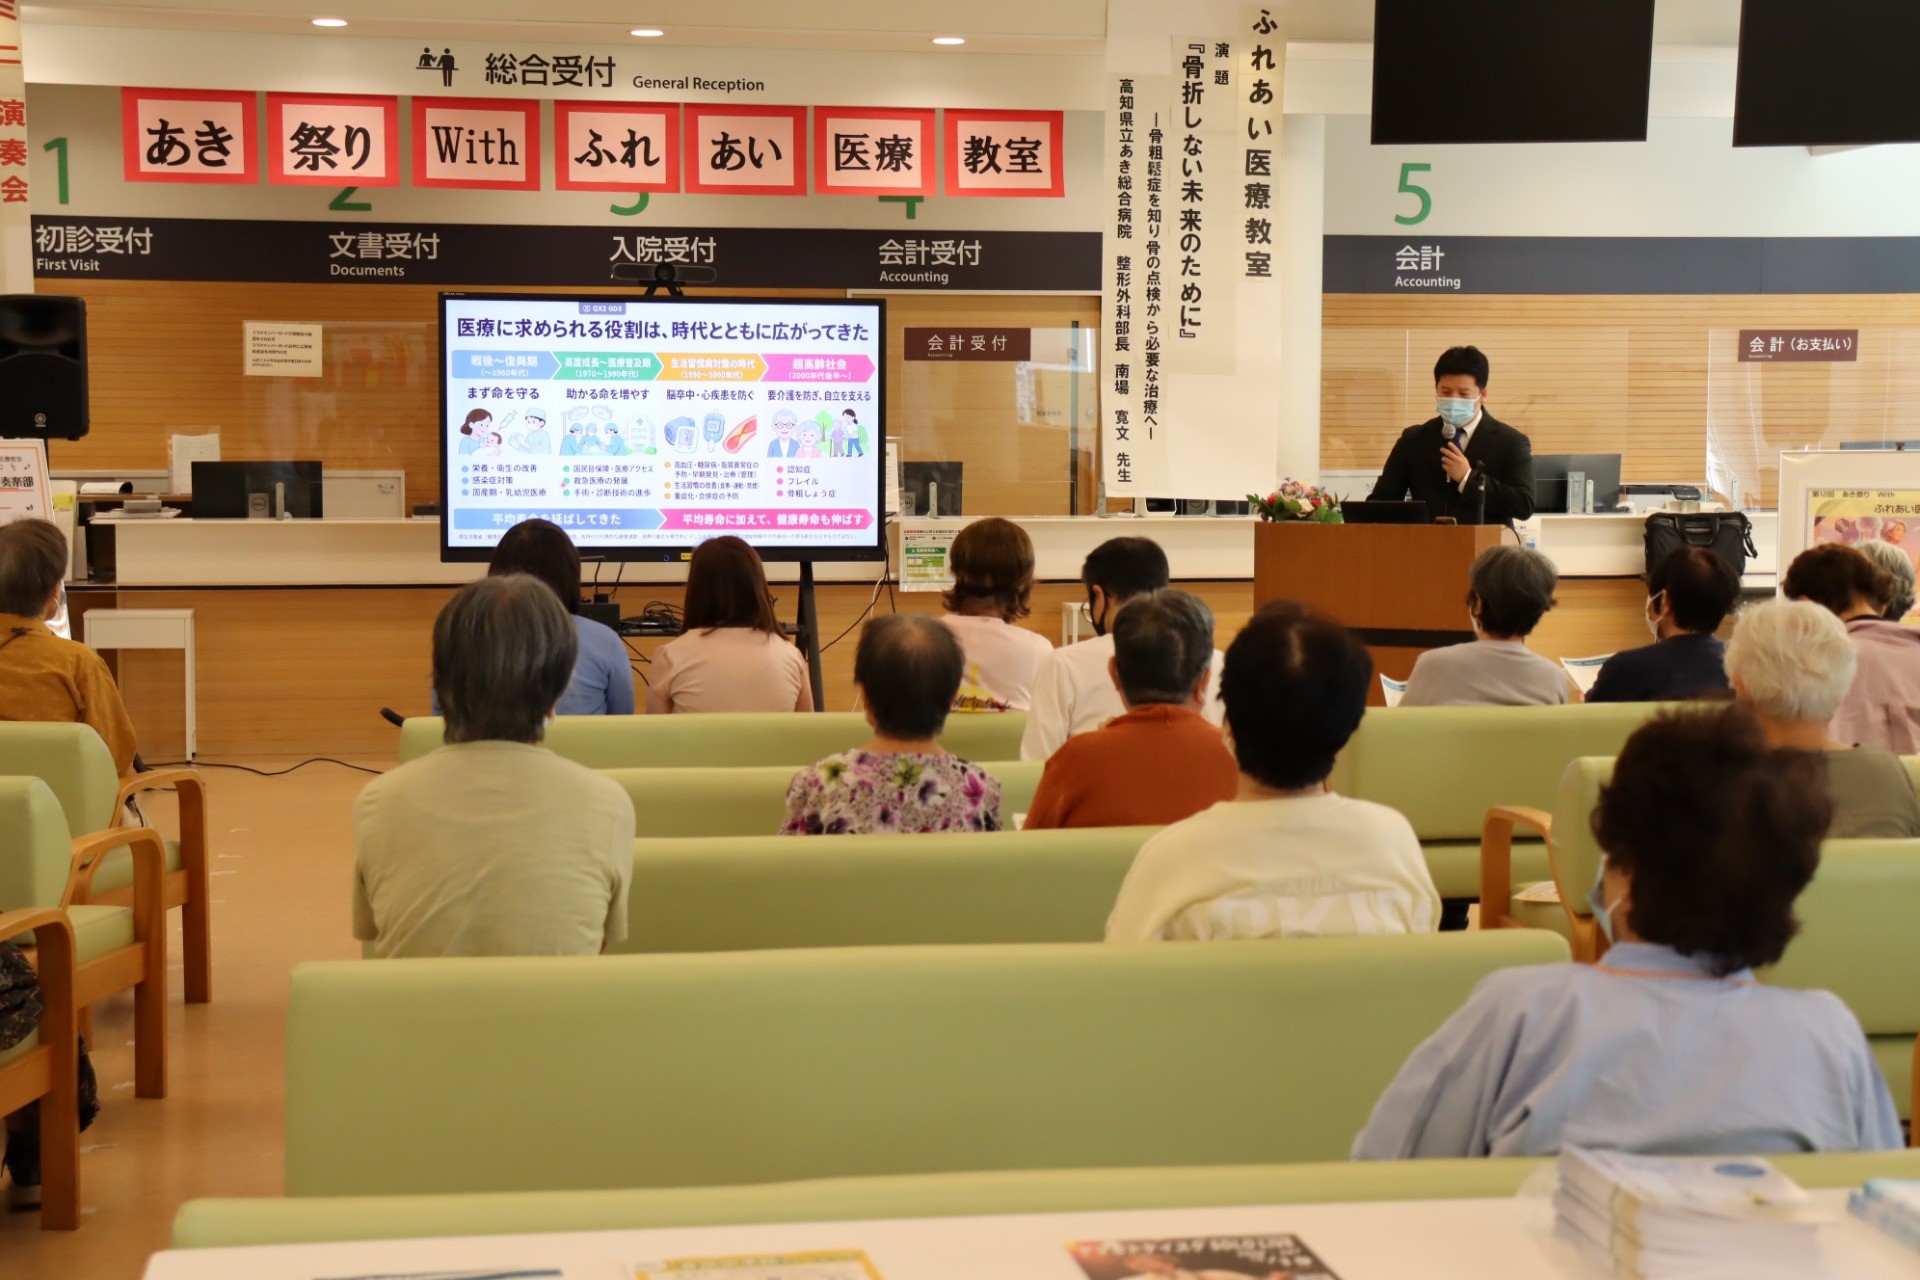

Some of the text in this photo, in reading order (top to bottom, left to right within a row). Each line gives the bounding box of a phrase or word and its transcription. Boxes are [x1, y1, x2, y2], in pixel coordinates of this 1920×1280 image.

[485, 53, 616, 88] 総合受付
[1214, 42, 1230, 86] 演題
[632, 76, 765, 93] General Reception
[146, 118, 1043, 175] あき 祭り With ふれ あい 医療 教室
[1245, 9, 1278, 278] ふれあい医療教室
[1117, 79, 1134, 239] 高知県立あき総合病院
[43, 137, 69, 205] 1
[1180, 43, 1205, 338] 『骨折しない未来のために』
[1394, 163, 1432, 225] 5
[35, 224, 154, 255] 初診受付
[328, 231, 441, 260] 文書受付
[609, 236, 717, 263] 入院受付
[878, 239, 982, 266] 会計受付
[1395, 245, 1445, 272] 会計
[36, 258, 100, 271] First Visit
[330, 264, 405, 277] Documents
[879, 271, 949, 285] Accounting
[1395, 276, 1461, 290] Accounting
[1115, 255, 1131, 352] 整形外科部長
[457, 317, 869, 342] 医療に求められる役割は、時代とともに広がってきた
[927, 334, 1008, 351] 会計受付
[792, 358, 847, 371] 超高齢社会
[467, 386, 540, 400] まず命を守る
[566, 388, 650, 400] 助かる命を増やす
[666, 388, 754, 401] 脳卒中・心疾患を防ぐ
[767, 389, 871, 402] 要介護を防ぎ、自立を支える
[787, 465, 811, 474] 認知症
[1116, 452, 1132, 483] 先生
[472, 476, 514, 485] 感染症対策
[787, 478, 819, 486] フレイル
[787, 489, 837, 499] 骨粗しょう症
[682, 513, 864, 526] 平均寿命に加えて、健康寿命も伸ばす
